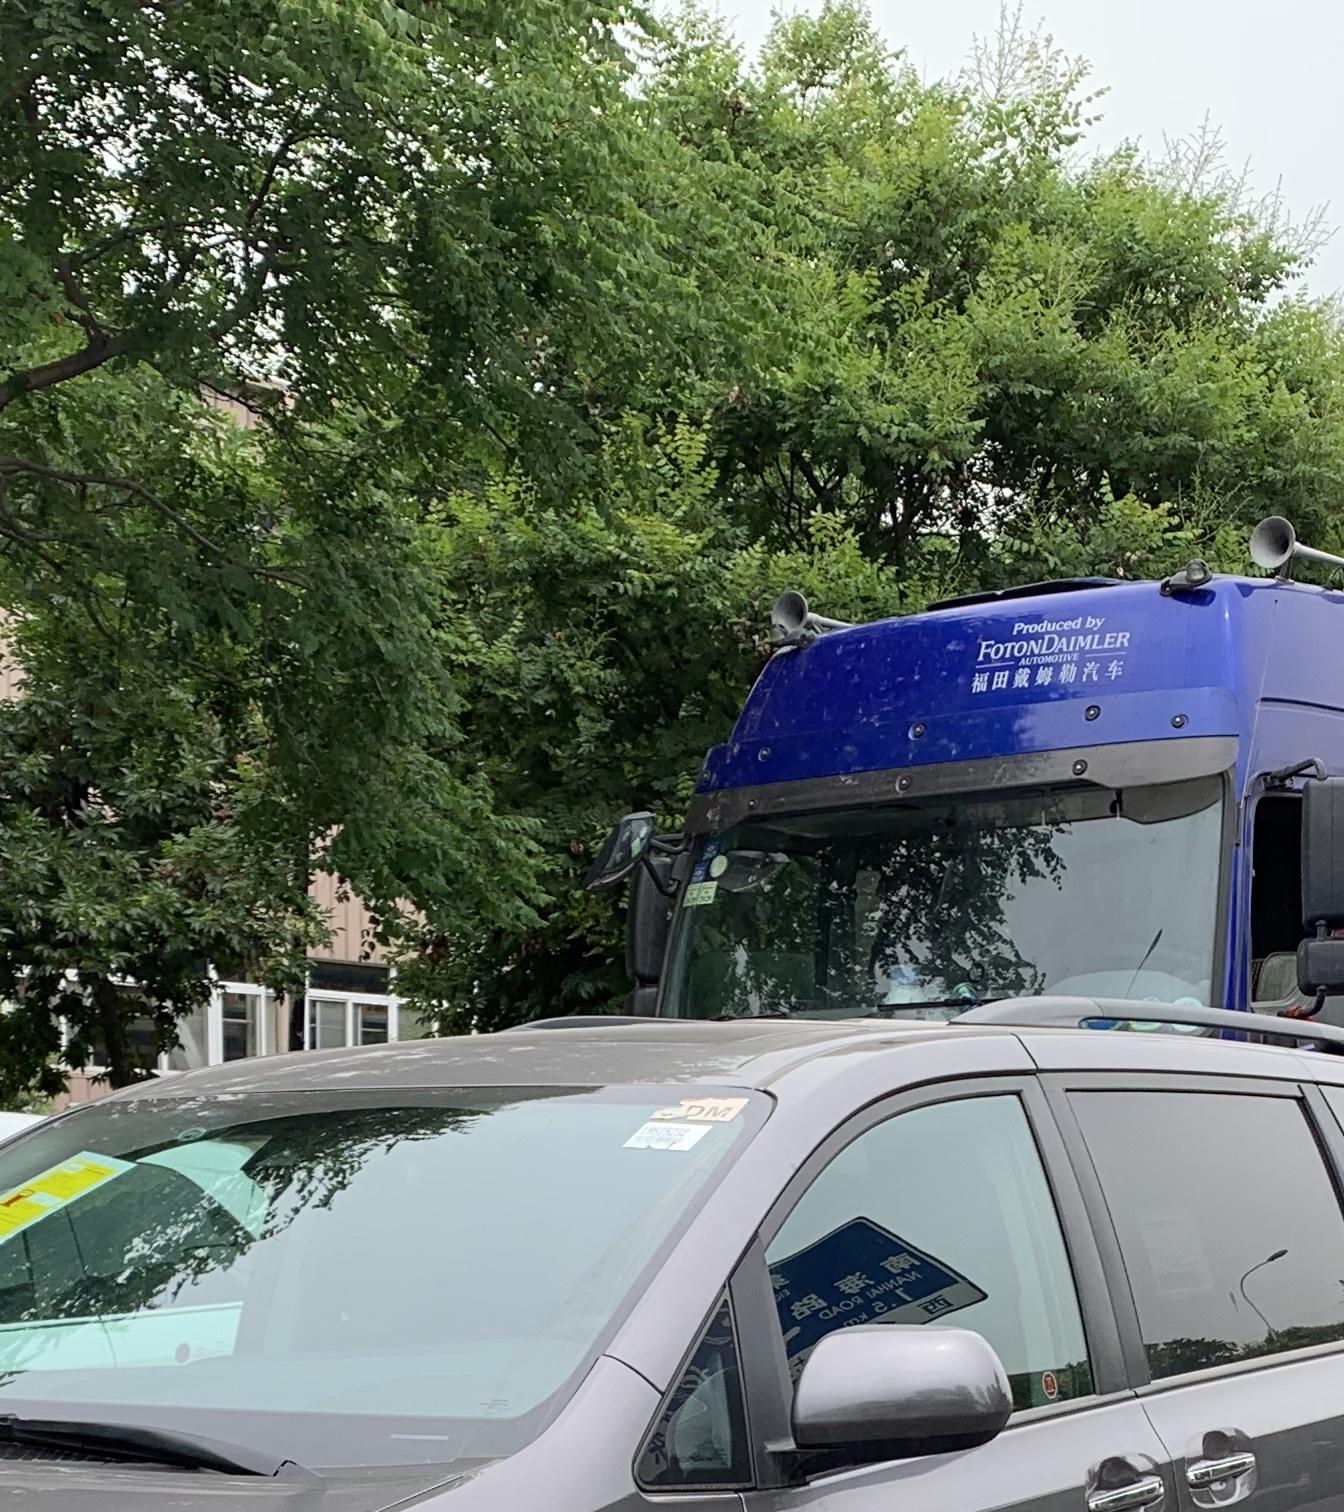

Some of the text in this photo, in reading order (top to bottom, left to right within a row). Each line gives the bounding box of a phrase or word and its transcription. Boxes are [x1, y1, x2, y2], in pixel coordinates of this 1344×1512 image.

[1012, 616, 1106, 635] Produced by
[1018, 652, 1080, 666] AUTOMOTIVE
[971, 660, 1125, 693] 福田戴姆勒汽车
